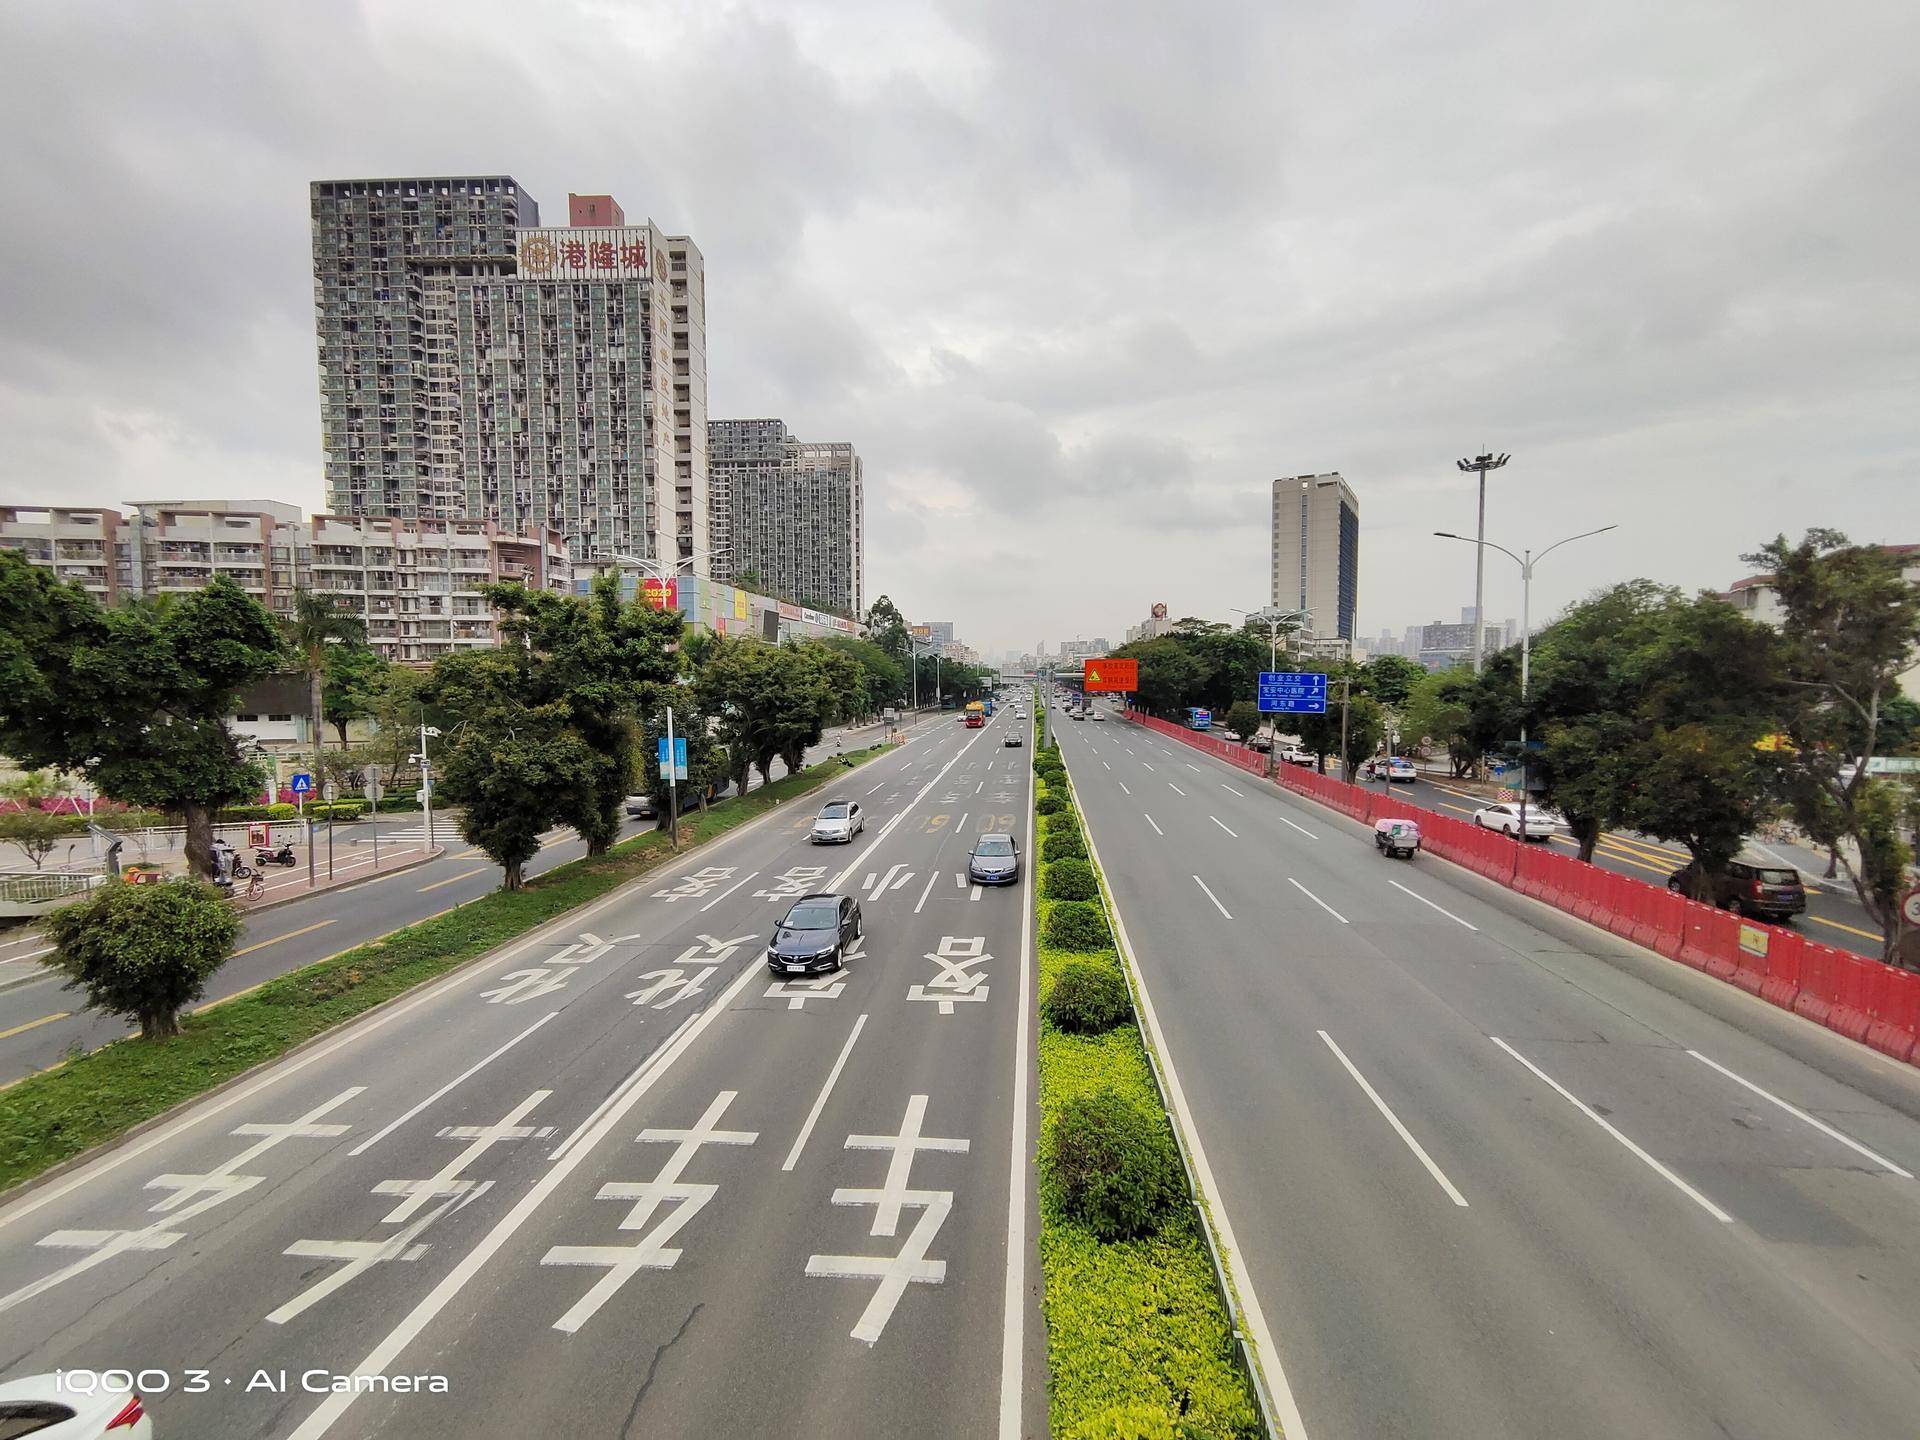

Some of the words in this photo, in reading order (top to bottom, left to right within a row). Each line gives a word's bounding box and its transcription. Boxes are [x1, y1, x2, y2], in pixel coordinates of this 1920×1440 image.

[559, 239, 648, 270] 港隆城
[645, 588, 672, 598] 2020
[1268, 674, 1302, 682] 创业立交
[1262, 686, 1305, 695] 宝安中心医院
